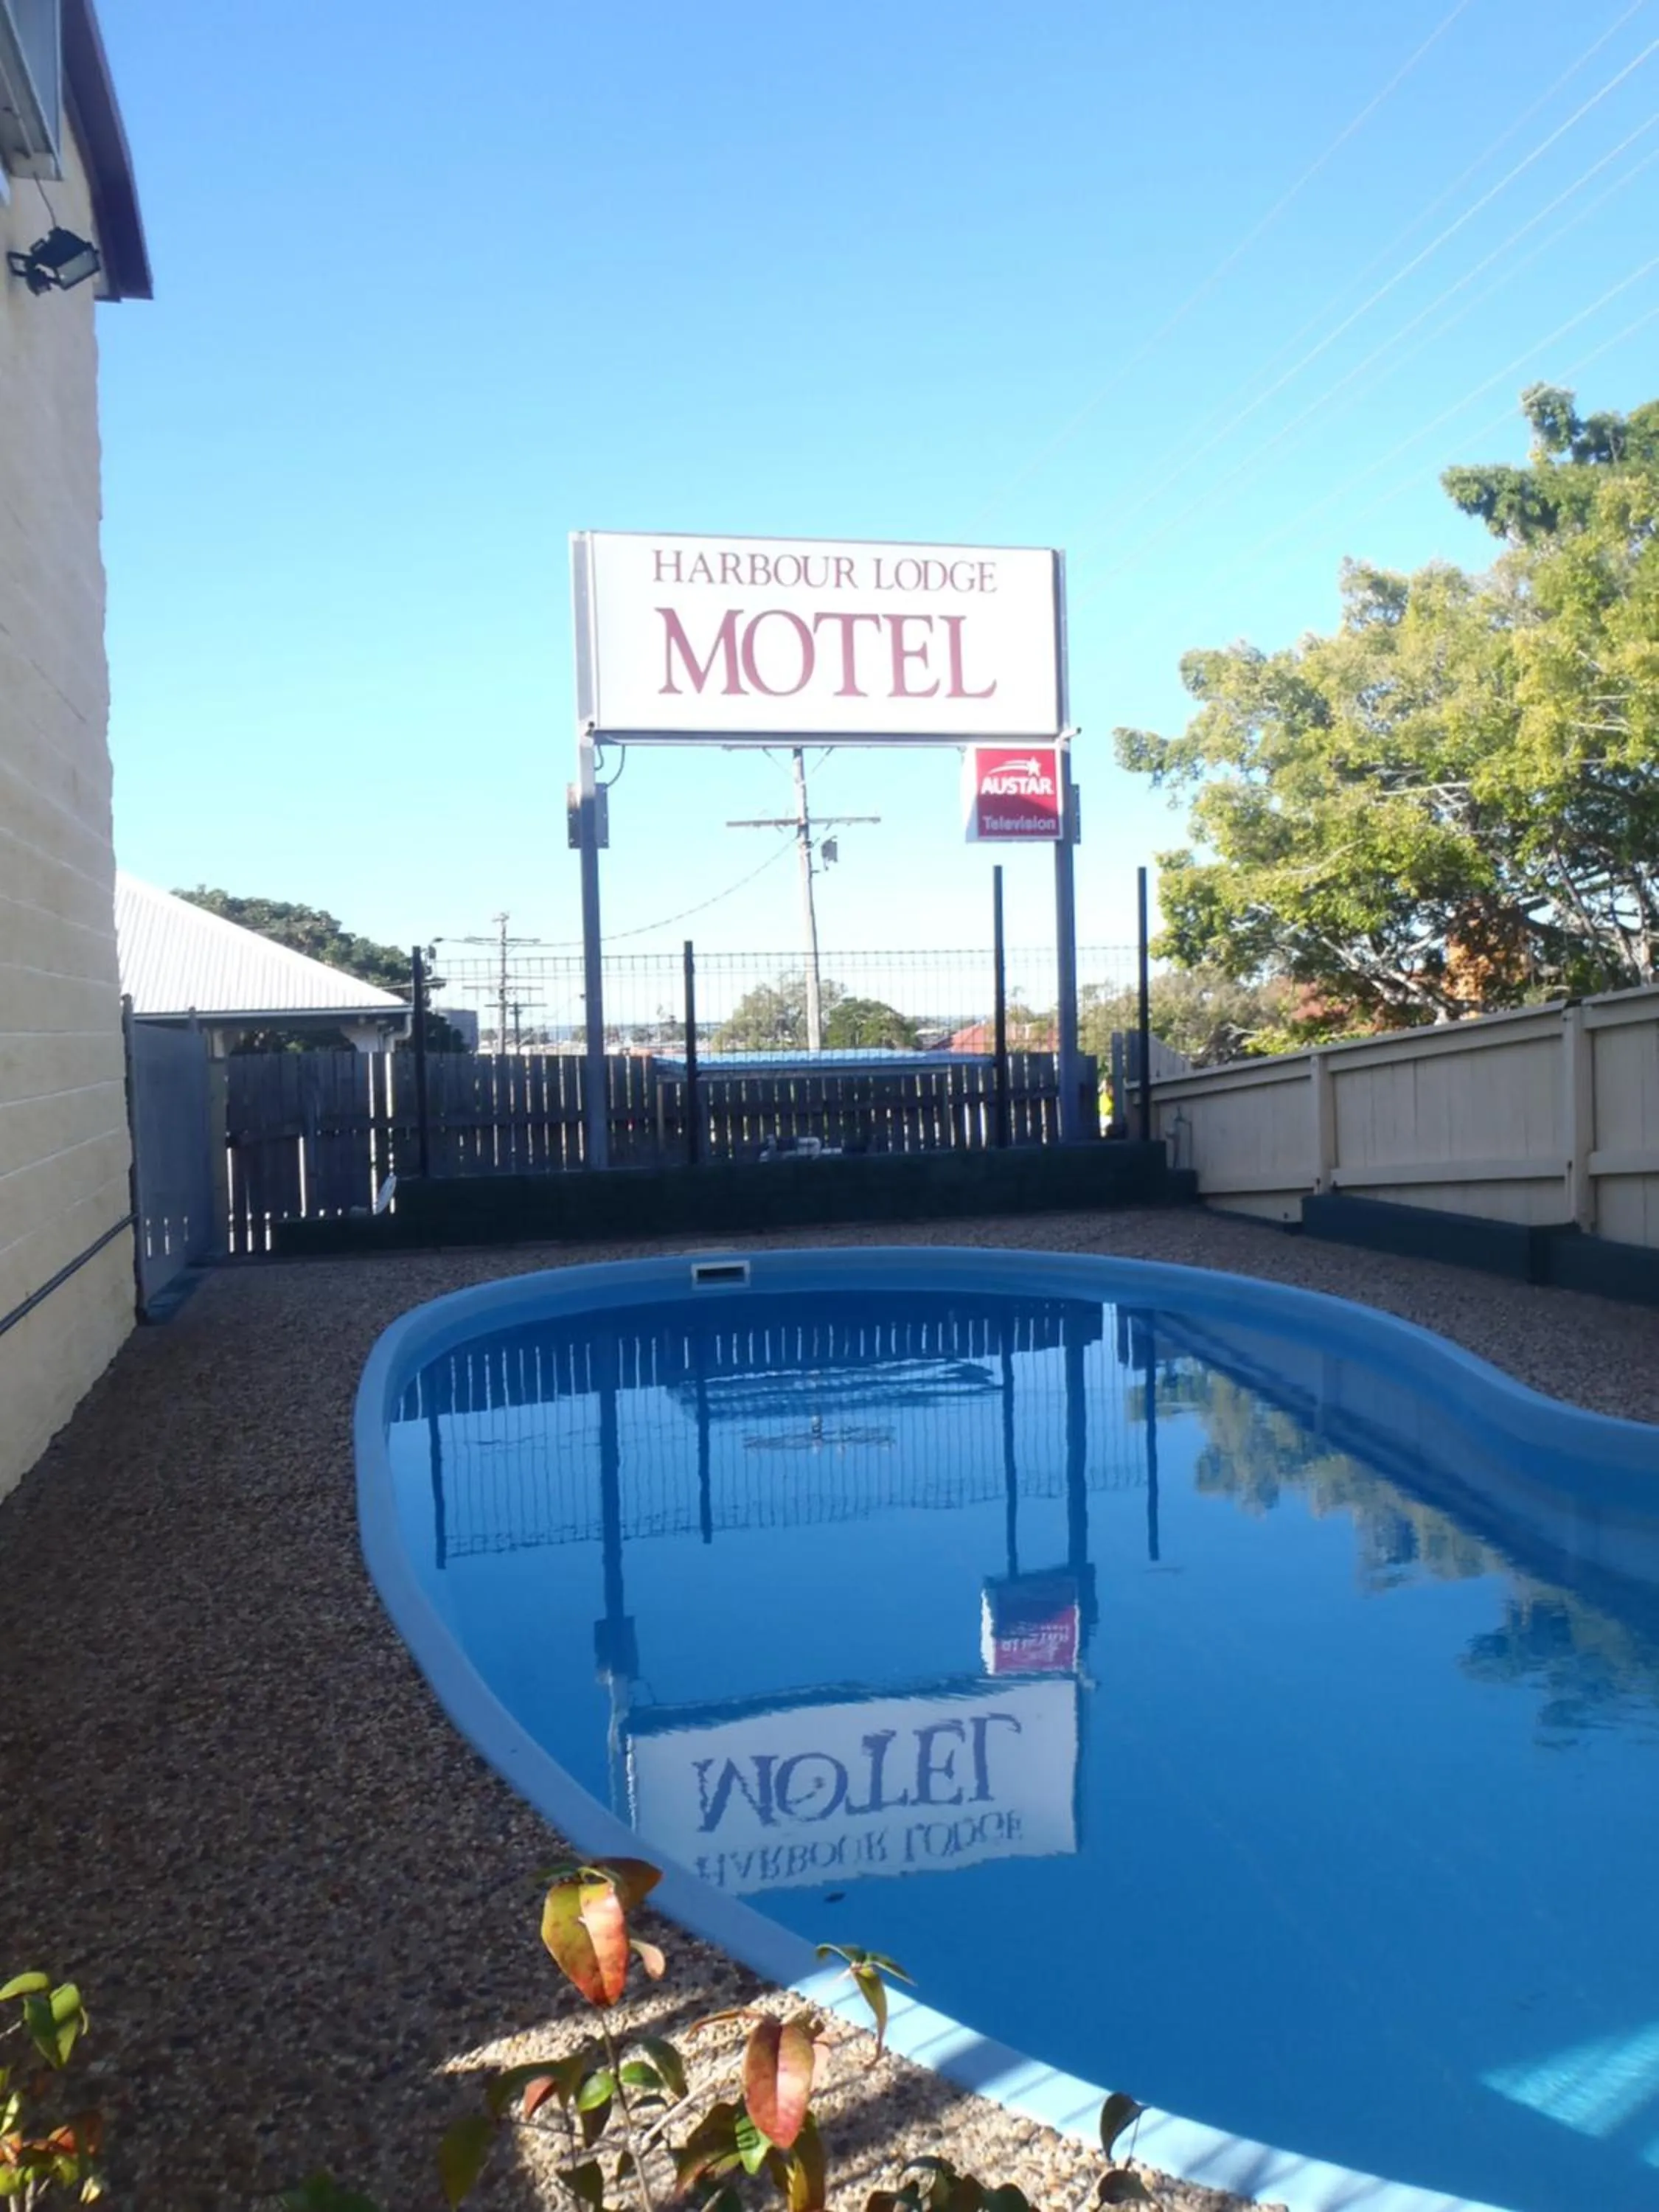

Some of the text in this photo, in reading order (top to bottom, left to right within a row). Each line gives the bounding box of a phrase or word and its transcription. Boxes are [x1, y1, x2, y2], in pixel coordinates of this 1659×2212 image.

[653, 549, 998, 593] HARBOUR LODGE
[655, 607, 997, 698] MOTEL
[981, 776, 1054, 795] AUSTAR
[983, 815, 1056, 830] Television
